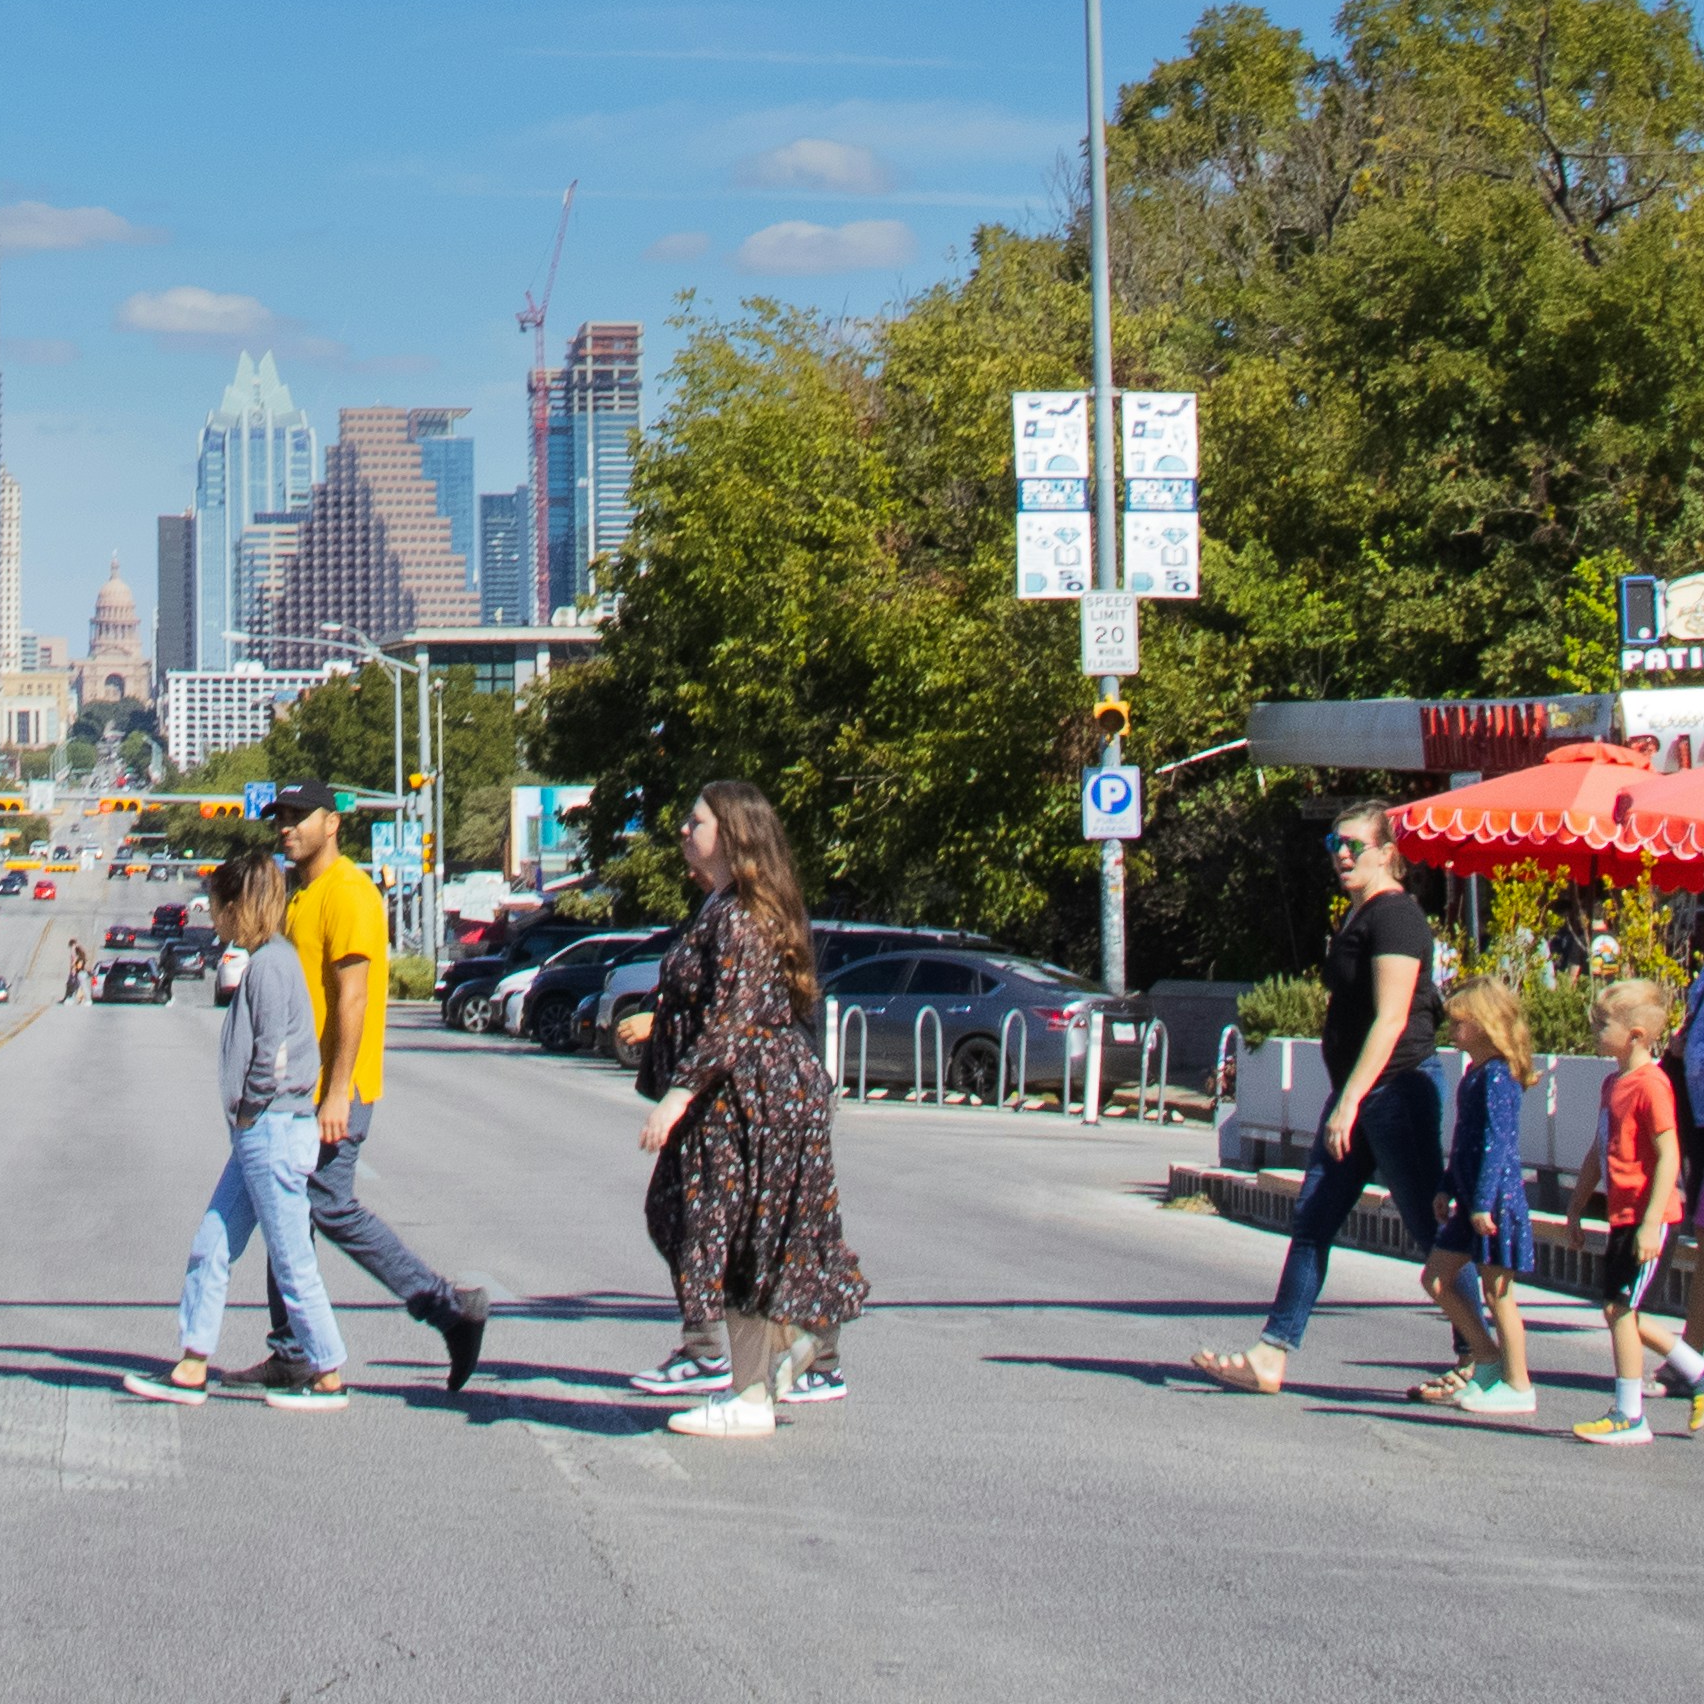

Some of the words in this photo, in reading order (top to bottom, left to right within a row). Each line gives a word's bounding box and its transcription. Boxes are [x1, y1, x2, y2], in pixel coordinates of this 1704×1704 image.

[1086, 596, 1132, 608] SPEED
[1091, 609, 1127, 621] LIMIT
[1095, 626, 1124, 644] 20
[1099, 777, 1127, 812] P
